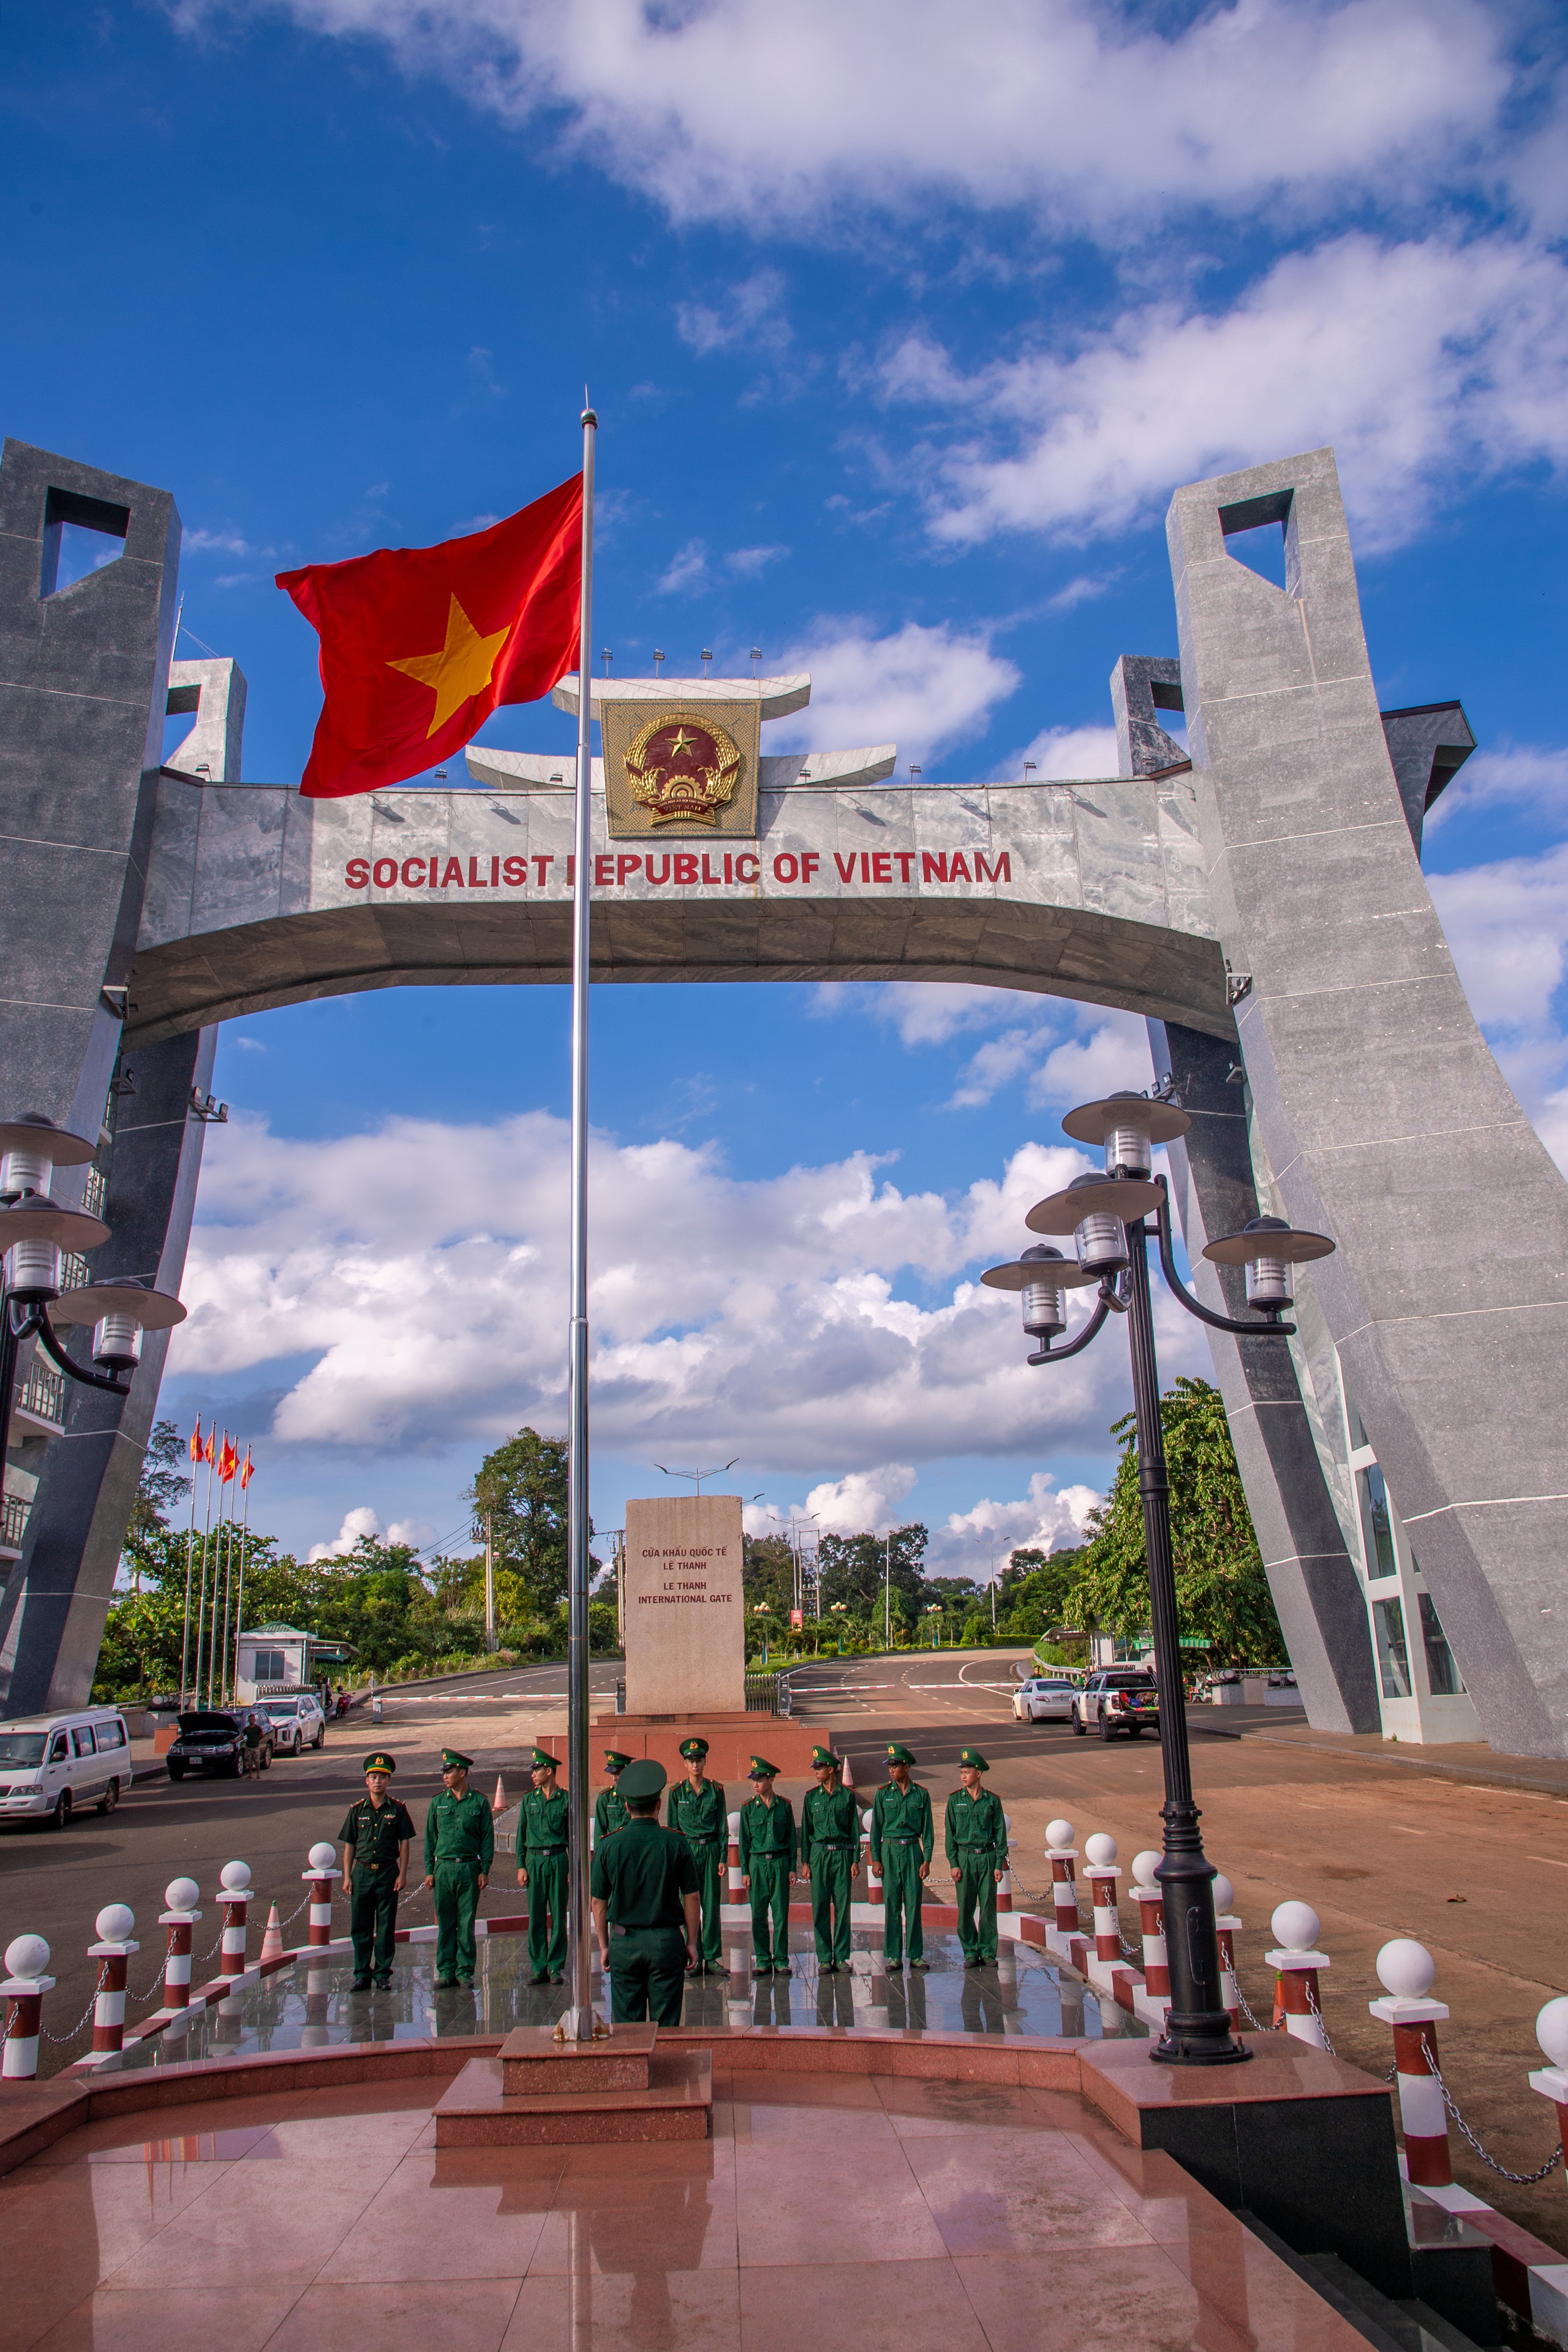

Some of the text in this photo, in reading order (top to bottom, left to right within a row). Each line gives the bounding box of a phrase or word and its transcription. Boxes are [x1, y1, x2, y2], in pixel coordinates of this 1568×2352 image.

[345, 856, 554, 889] SOCIALIST
[774, 852, 820, 884] OF
[643, 1545, 728, 1557] CỬA KHẨU QUỐC TẾ
[663, 1560, 674, 1571] LỆ
[638, 1595, 707, 1604] INTERNATIONAL
